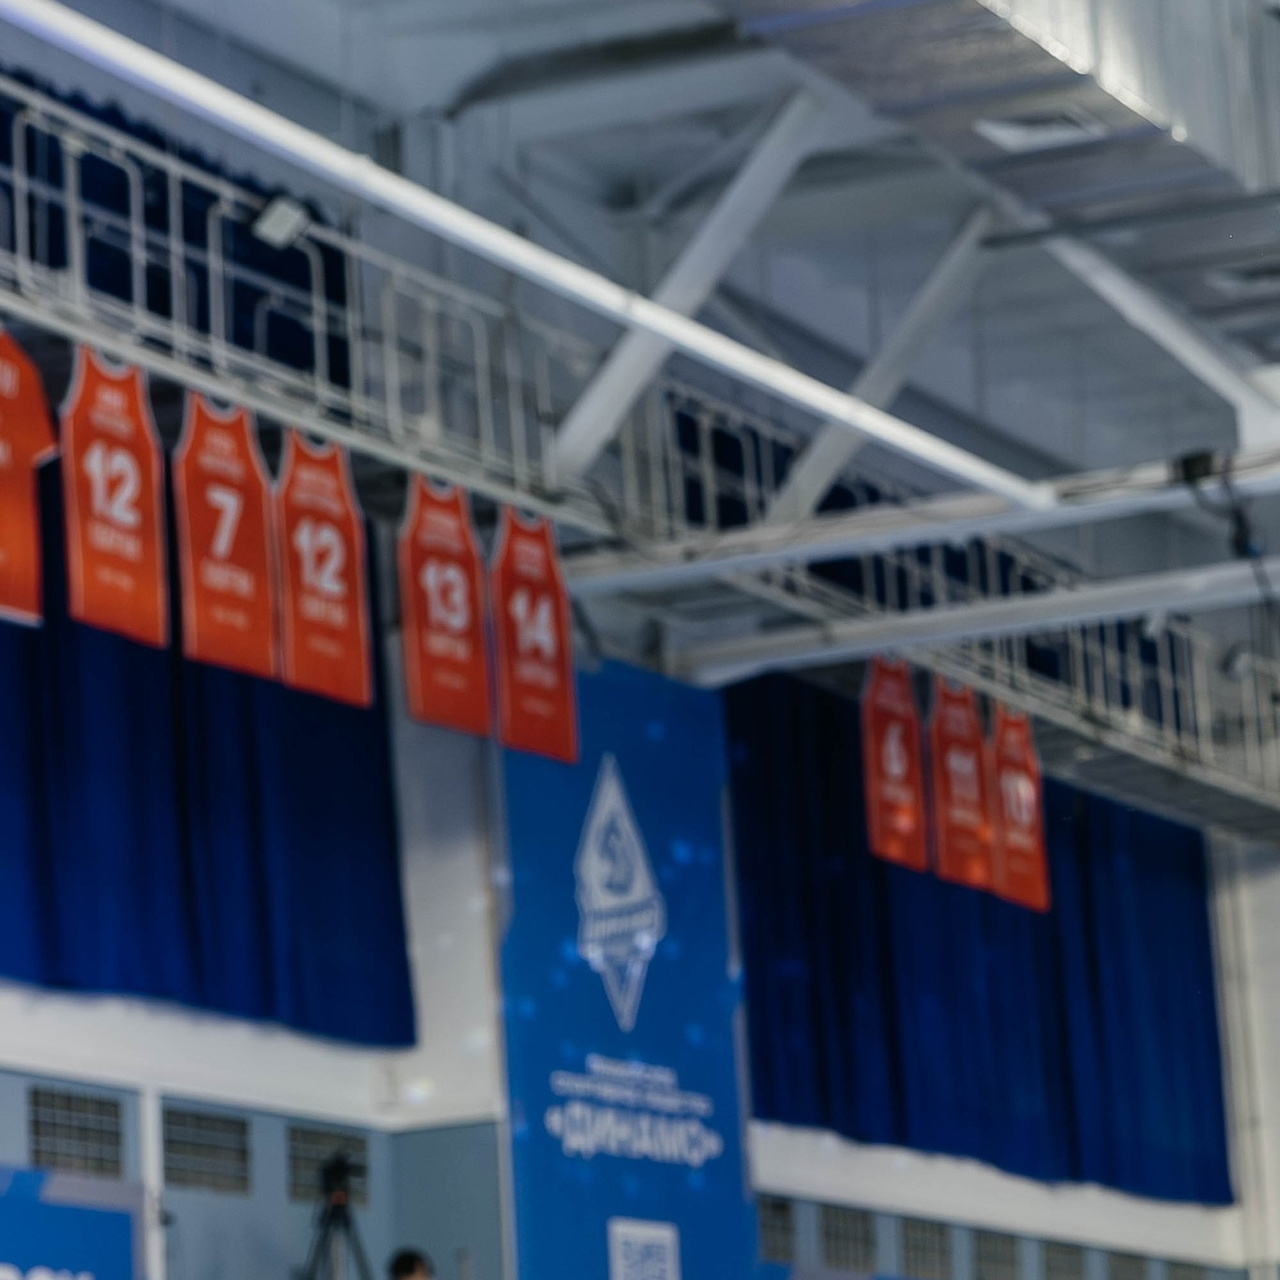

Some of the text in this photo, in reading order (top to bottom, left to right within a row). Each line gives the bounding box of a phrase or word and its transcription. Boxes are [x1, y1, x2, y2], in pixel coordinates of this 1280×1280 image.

[84, 442, 141, 529] 12
[206, 485, 242, 559] 7
[293, 520, 346, 596] 12
